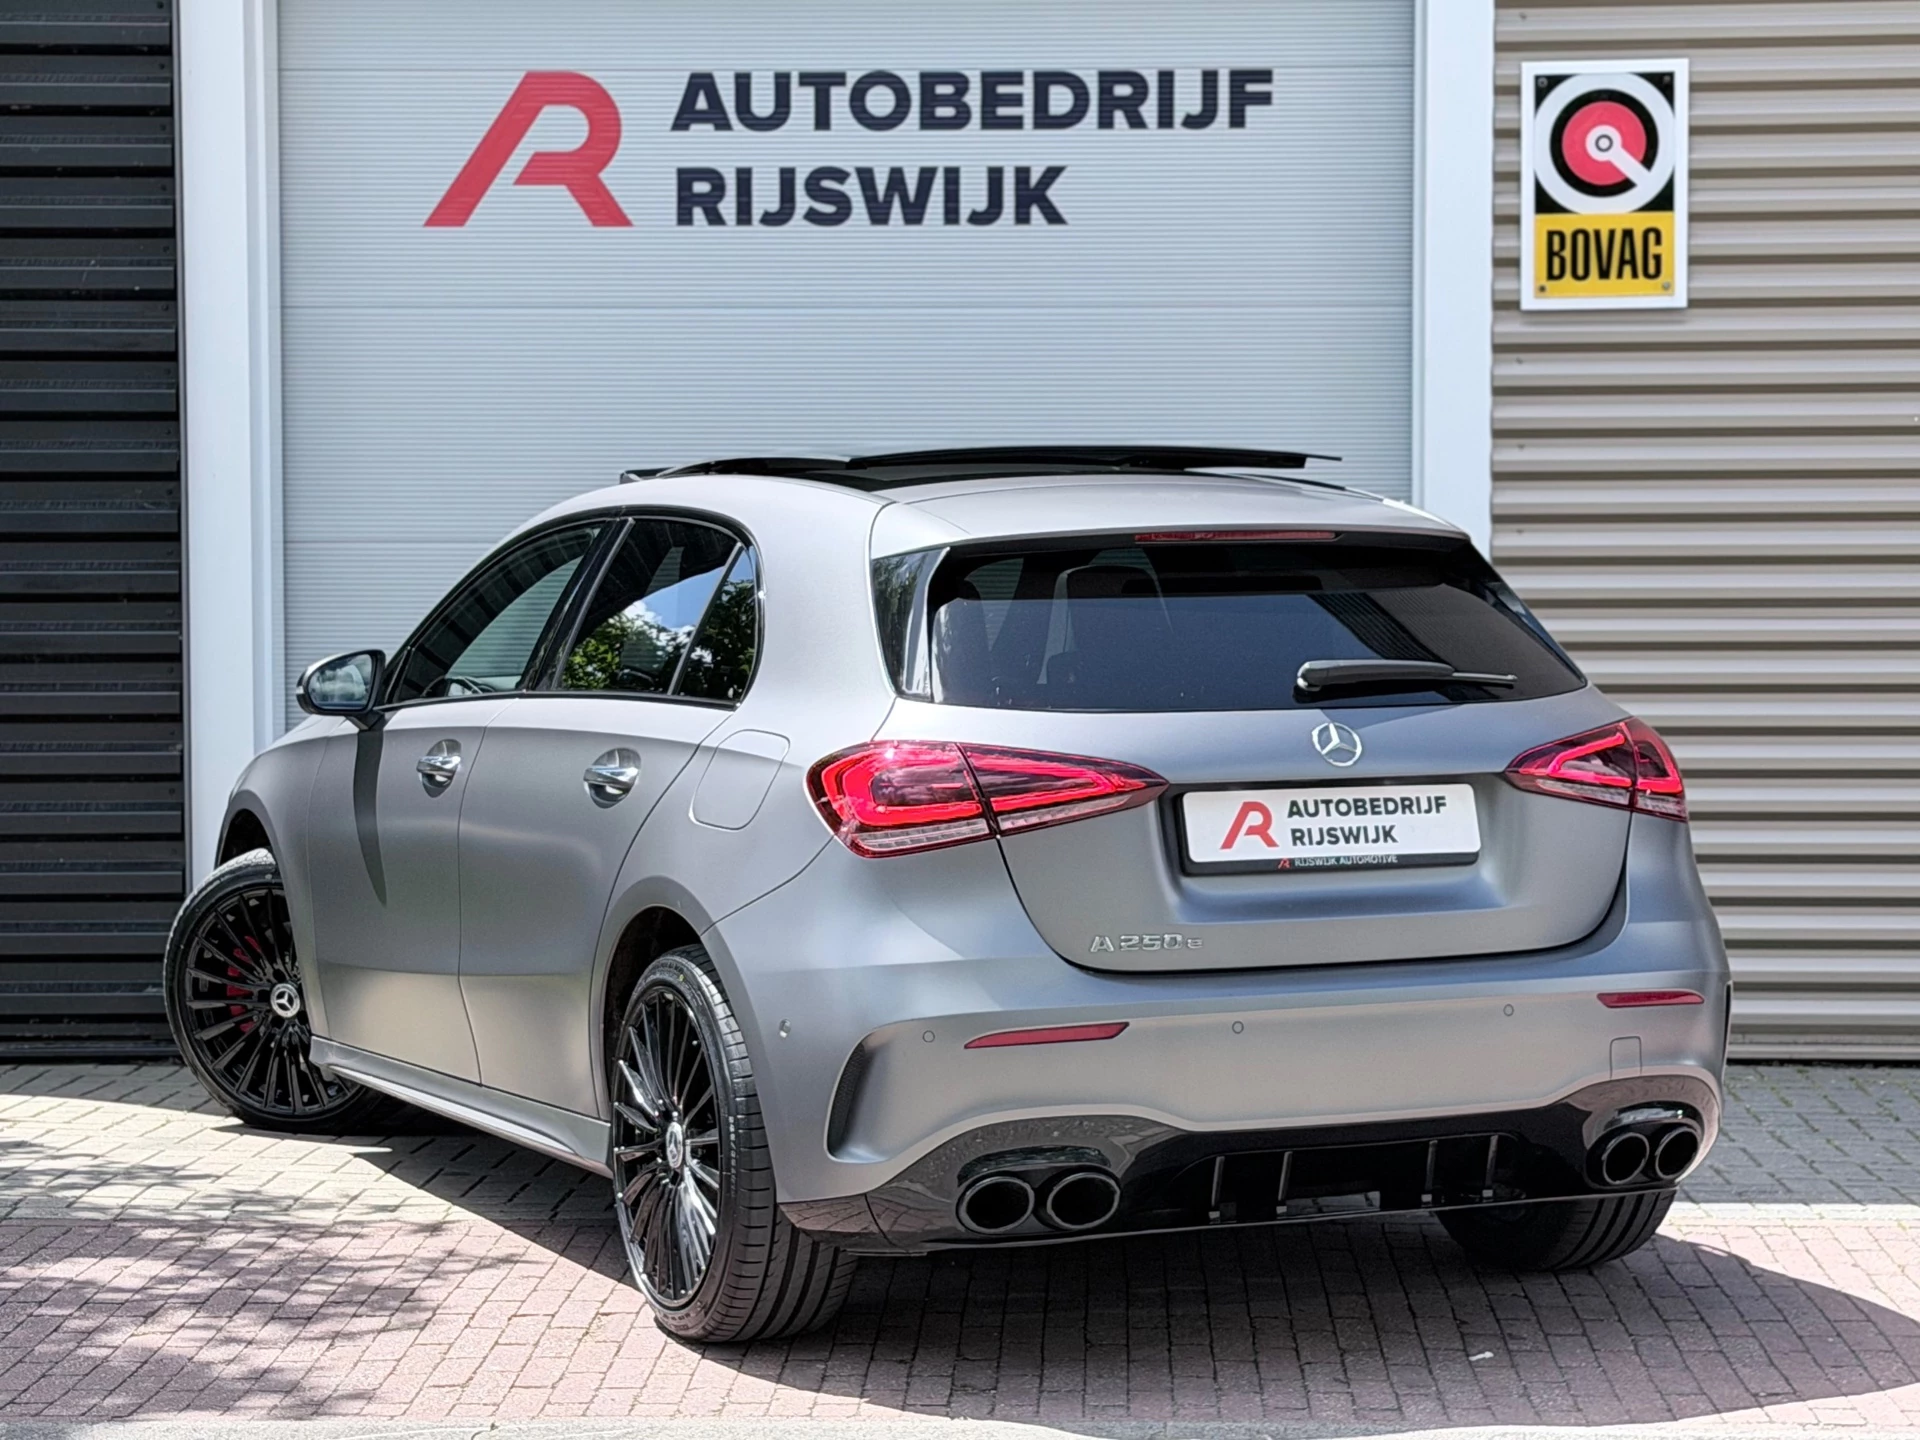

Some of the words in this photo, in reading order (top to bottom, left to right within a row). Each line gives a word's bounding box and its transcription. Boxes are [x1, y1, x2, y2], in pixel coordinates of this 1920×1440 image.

[671, 69, 1274, 132] AUTOBEDRIJF
[676, 166, 1067, 227] RIJSWIJK
[1546, 227, 1663, 282] BOVAG
[1287, 796, 1447, 818] AUTOBEDRIJF
[1290, 825, 1398, 847] RIJSWIJK
[1294, 857, 1338, 867] RIJSWIJK
[1339, 854, 1399, 866] AUTOMOTIVE
